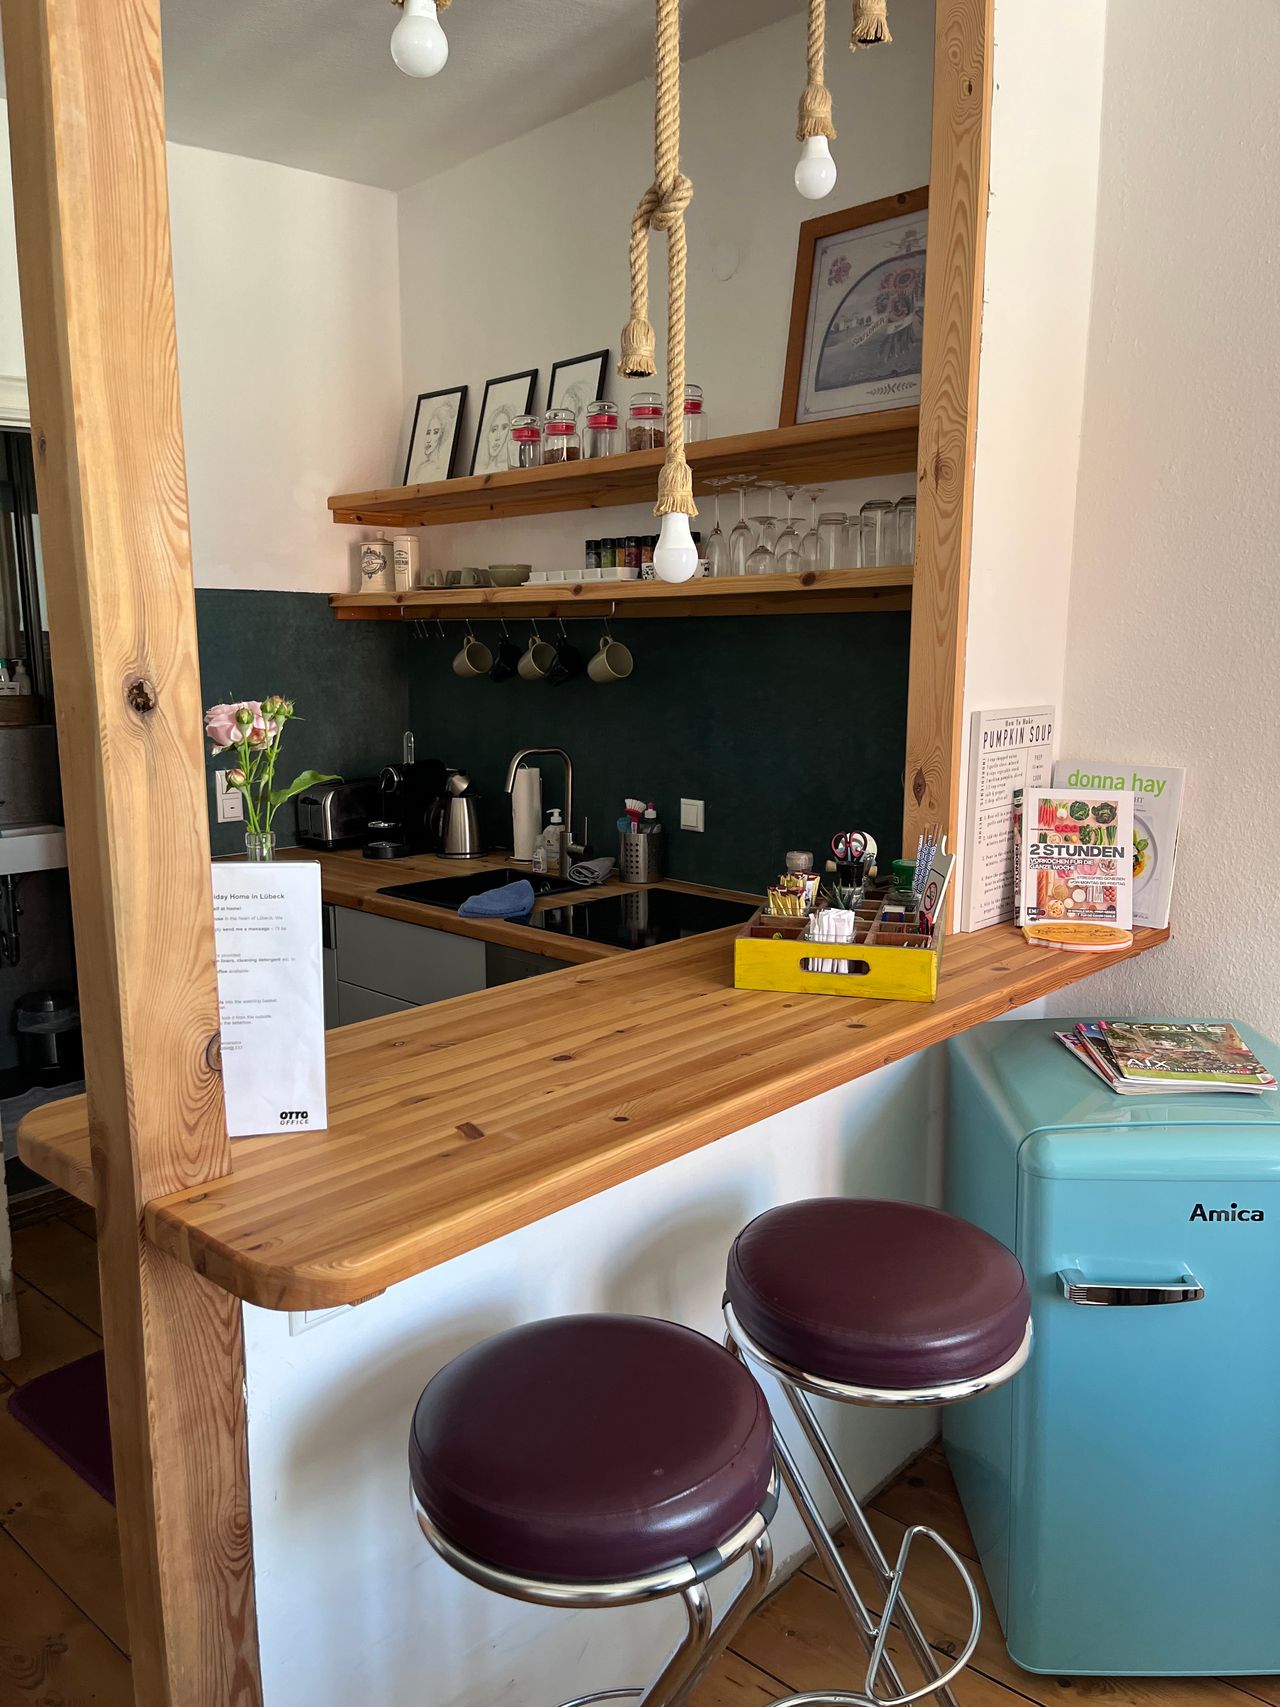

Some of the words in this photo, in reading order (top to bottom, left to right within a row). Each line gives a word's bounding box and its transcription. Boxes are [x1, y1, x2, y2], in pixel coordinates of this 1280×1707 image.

[983, 727, 1025, 749] PUMPKIN
[1029, 724, 1052, 742] SOUP
[1068, 768, 1125, 790] donna
[1132, 773, 1167, 797] hay
[1030, 844, 1040, 855] 2
[1043, 845, 1125, 858] STUNDEN
[1127, 1058, 1170, 1068] AIX
[280, 1111, 308, 1120] OTTO
[1188, 1202, 1264, 1221] Amica
